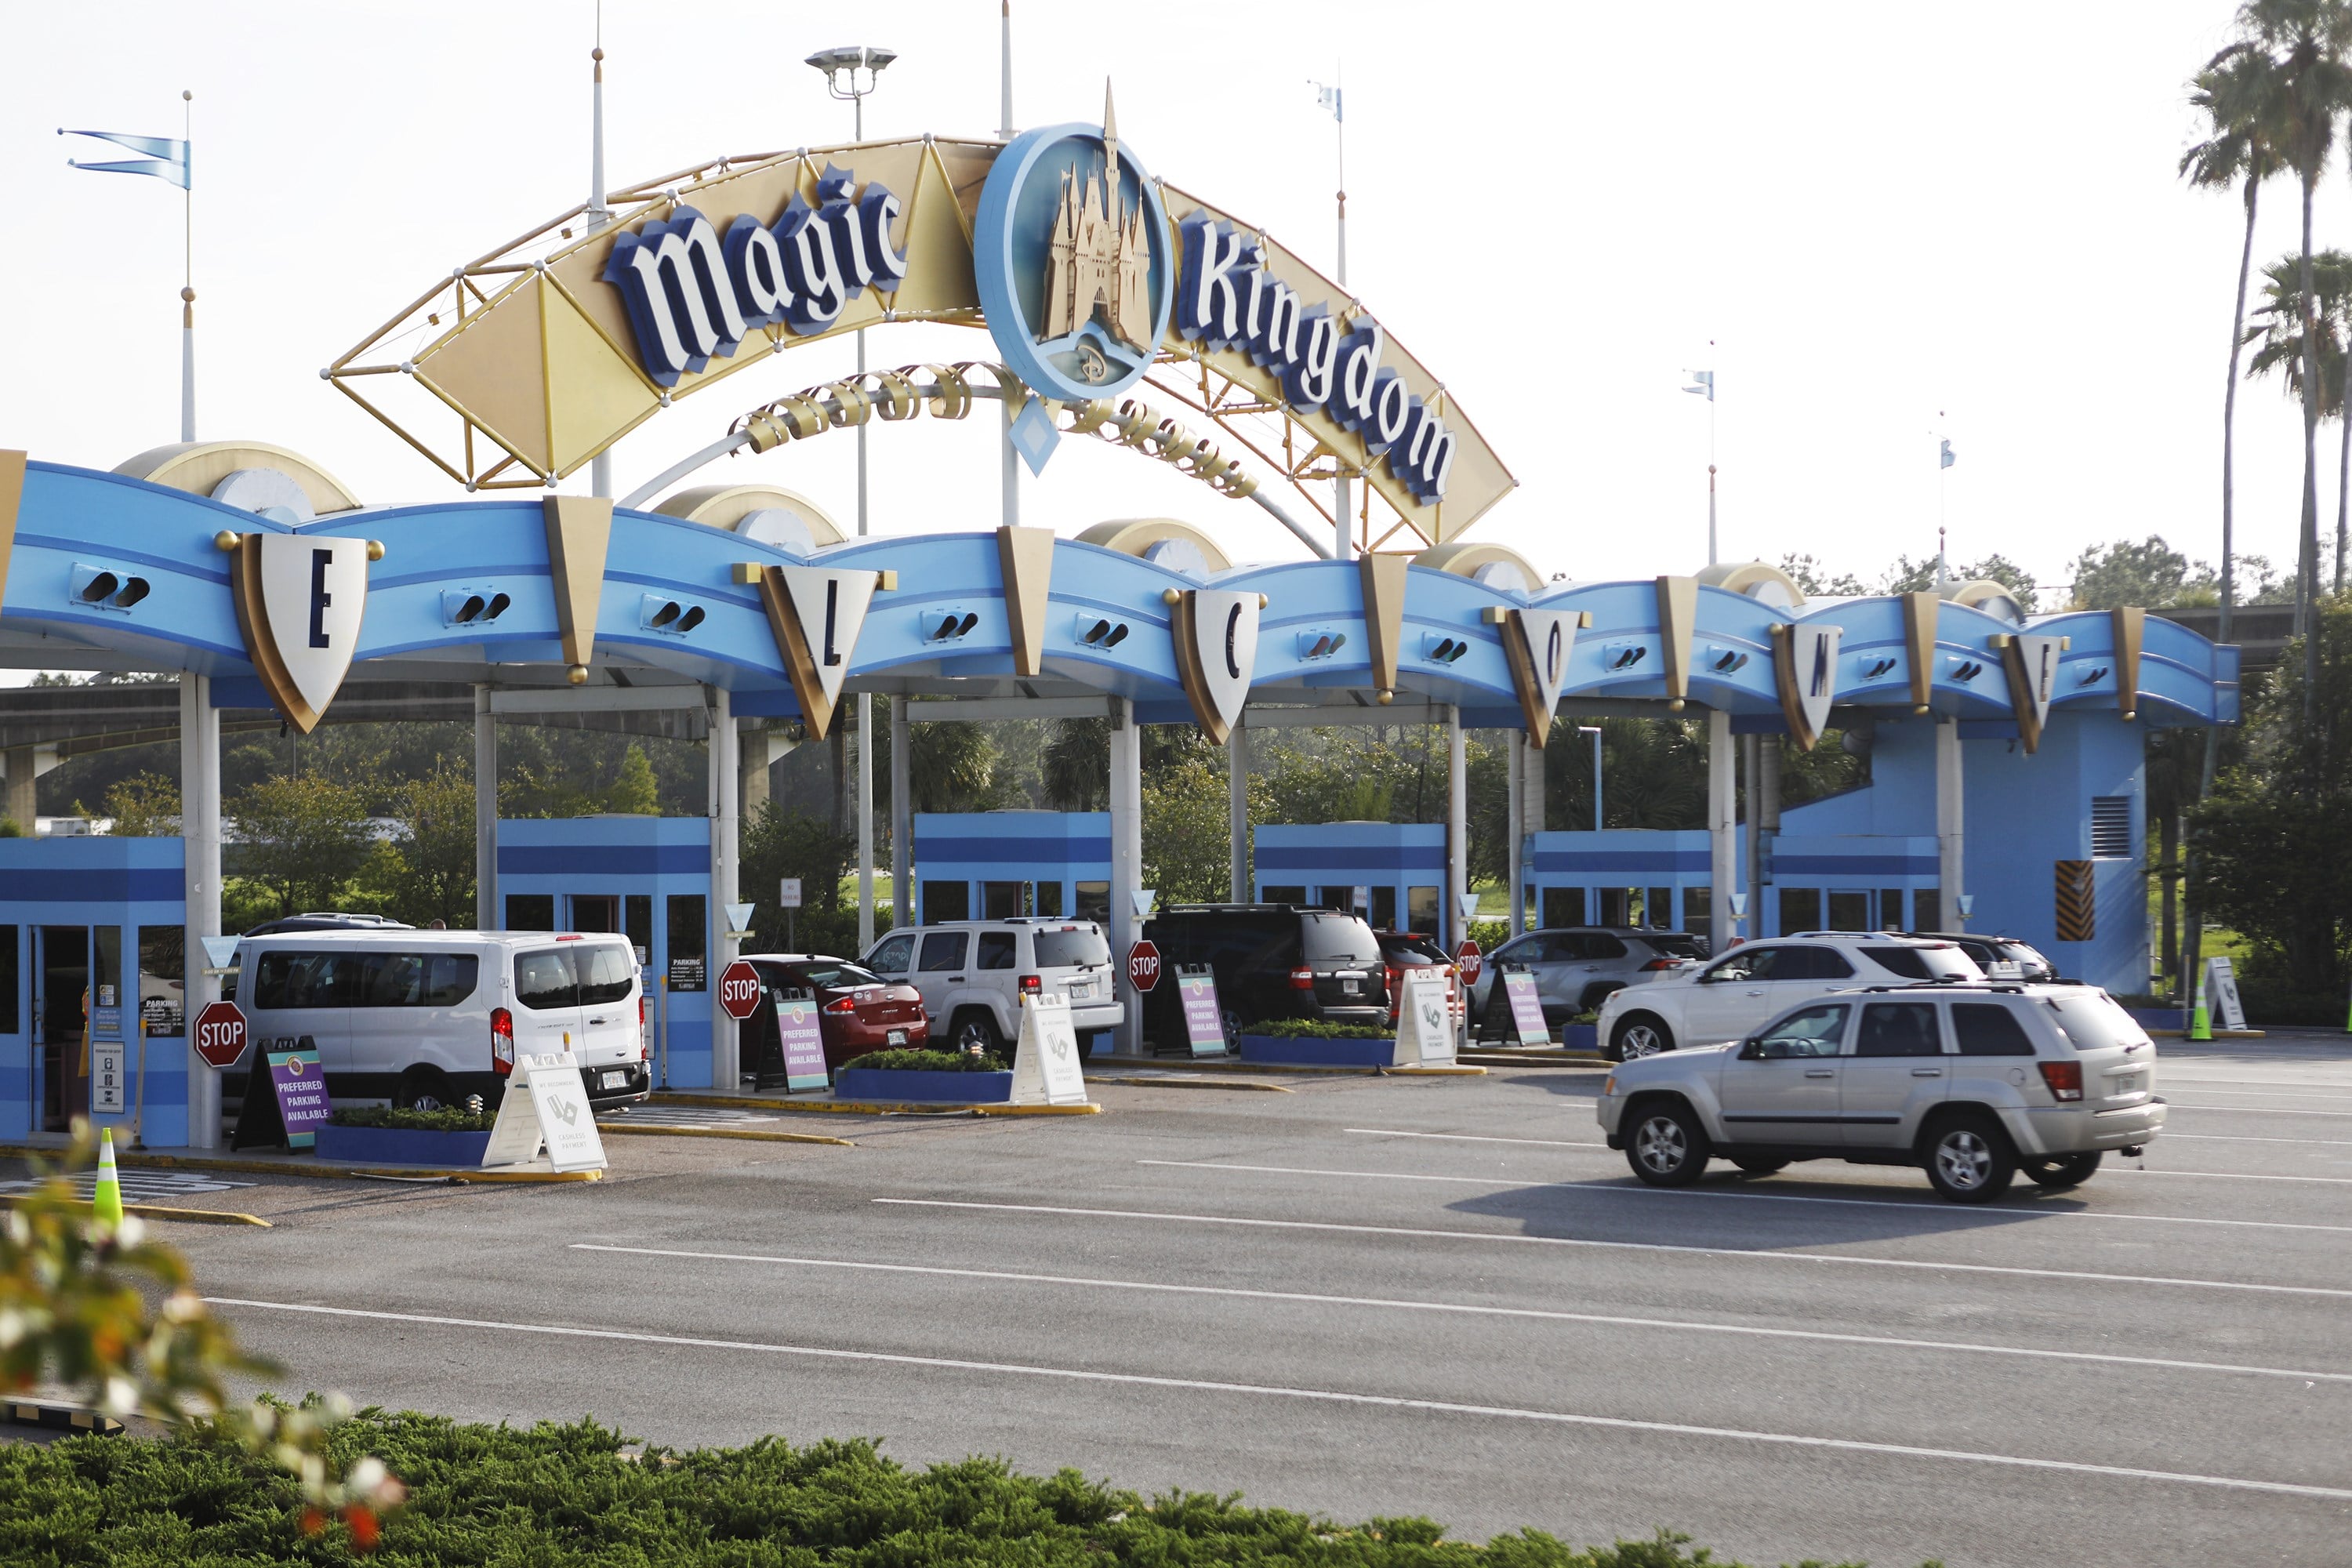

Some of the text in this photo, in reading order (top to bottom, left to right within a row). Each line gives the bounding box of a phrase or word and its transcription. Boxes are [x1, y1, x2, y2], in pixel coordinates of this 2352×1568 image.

[631, 179, 1457, 495] Magic Kingdom
[1132, 956, 1158, 976] STOP
[1459, 955, 1480, 972] STOP
[724, 979, 757, 1001] STOP
[1185, 1000, 1215, 1009] PREFERRED
[1192, 1011, 1214, 1020] PARKING
[1192, 1022, 1219, 1032] AVAILABLE
[201, 1021, 244, 1047] STOP
[783, 1028, 818, 1039] PREFERRED
[789, 1041, 816, 1051] PARKING
[789, 1054, 822, 1065] AVAILABLE
[278, 1080, 323, 1093] PREFERRED
[287, 1095, 321, 1107] PARKING
[288, 1109, 328, 1122] AVAILABLE
[558, 1132, 586, 1141] CASHLESS
[561, 1141, 587, 1149] PAYMENT
